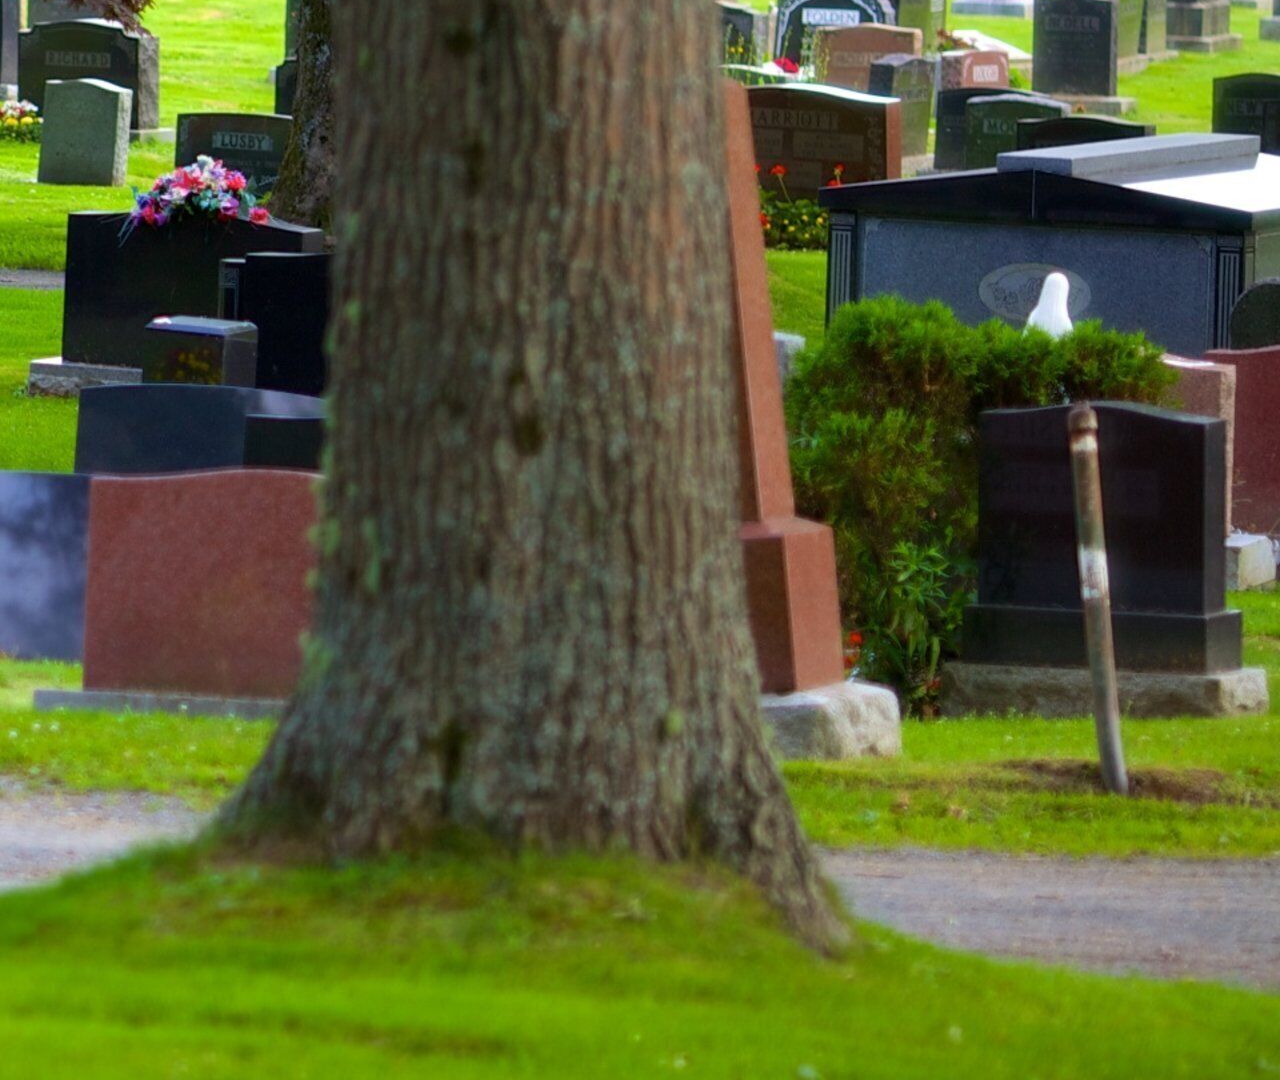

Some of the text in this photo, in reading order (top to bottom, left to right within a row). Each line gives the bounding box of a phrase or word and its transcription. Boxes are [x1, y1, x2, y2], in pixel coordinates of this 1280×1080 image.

[48, 51, 108, 67] RICHARD
[752, 109, 835, 129] ARRIOTT
[221, 133, 266, 149] LUSBY
